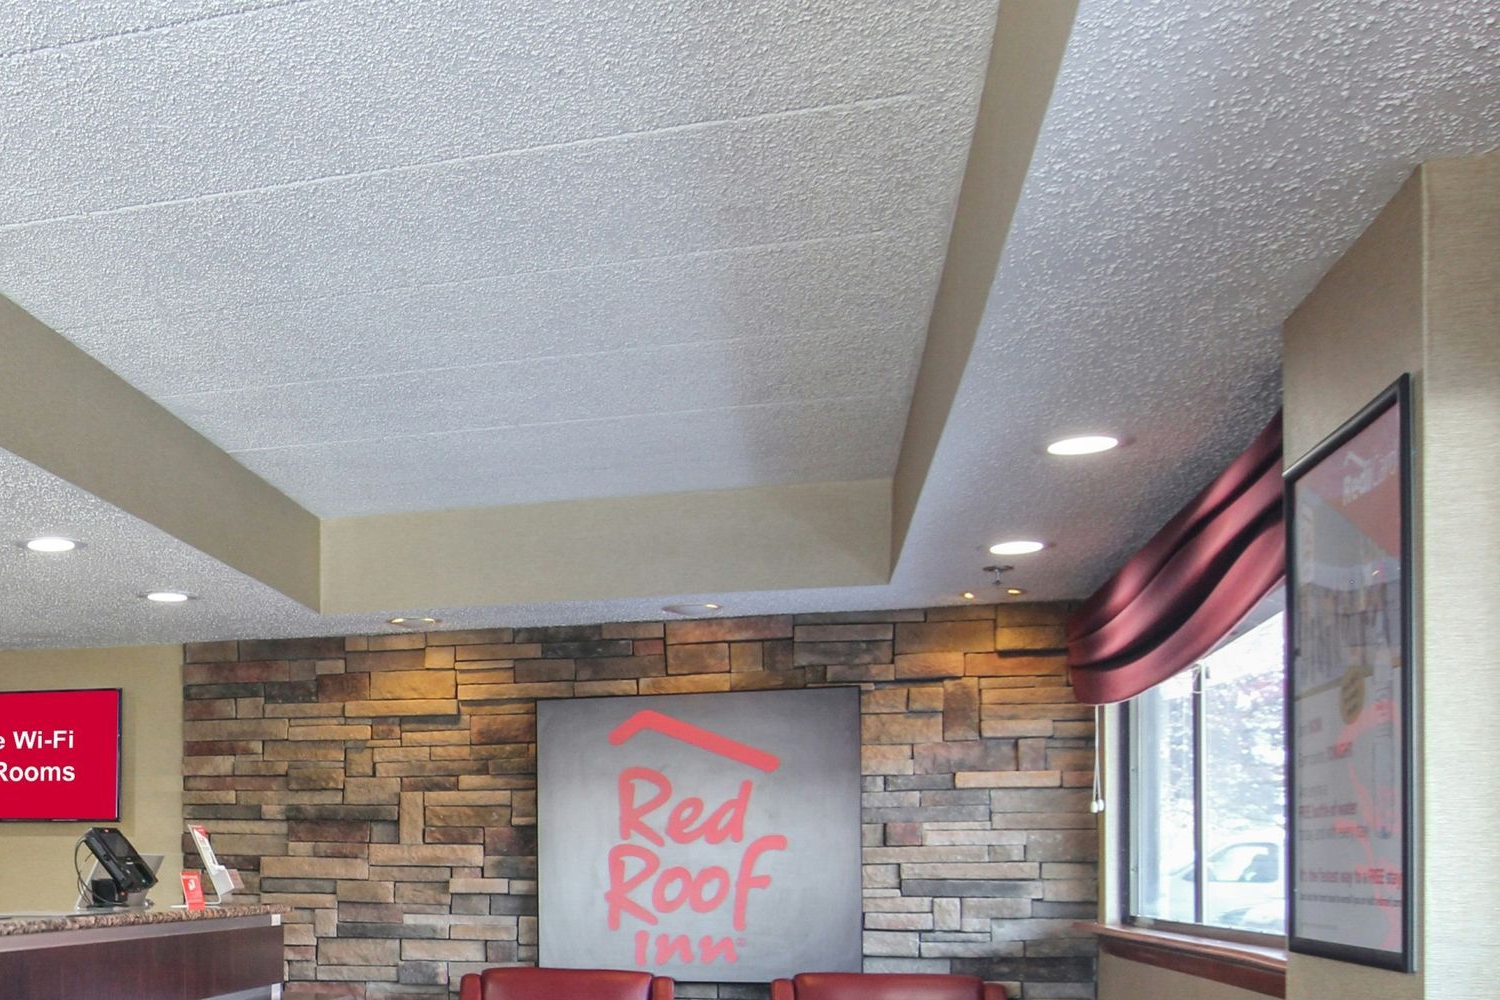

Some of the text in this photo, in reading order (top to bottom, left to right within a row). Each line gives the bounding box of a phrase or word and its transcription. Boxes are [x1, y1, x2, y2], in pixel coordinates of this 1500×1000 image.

[12, 730, 75, 750] Wi-Fi
[618, 766, 753, 847] Red
[604, 835, 788, 931] Roof
